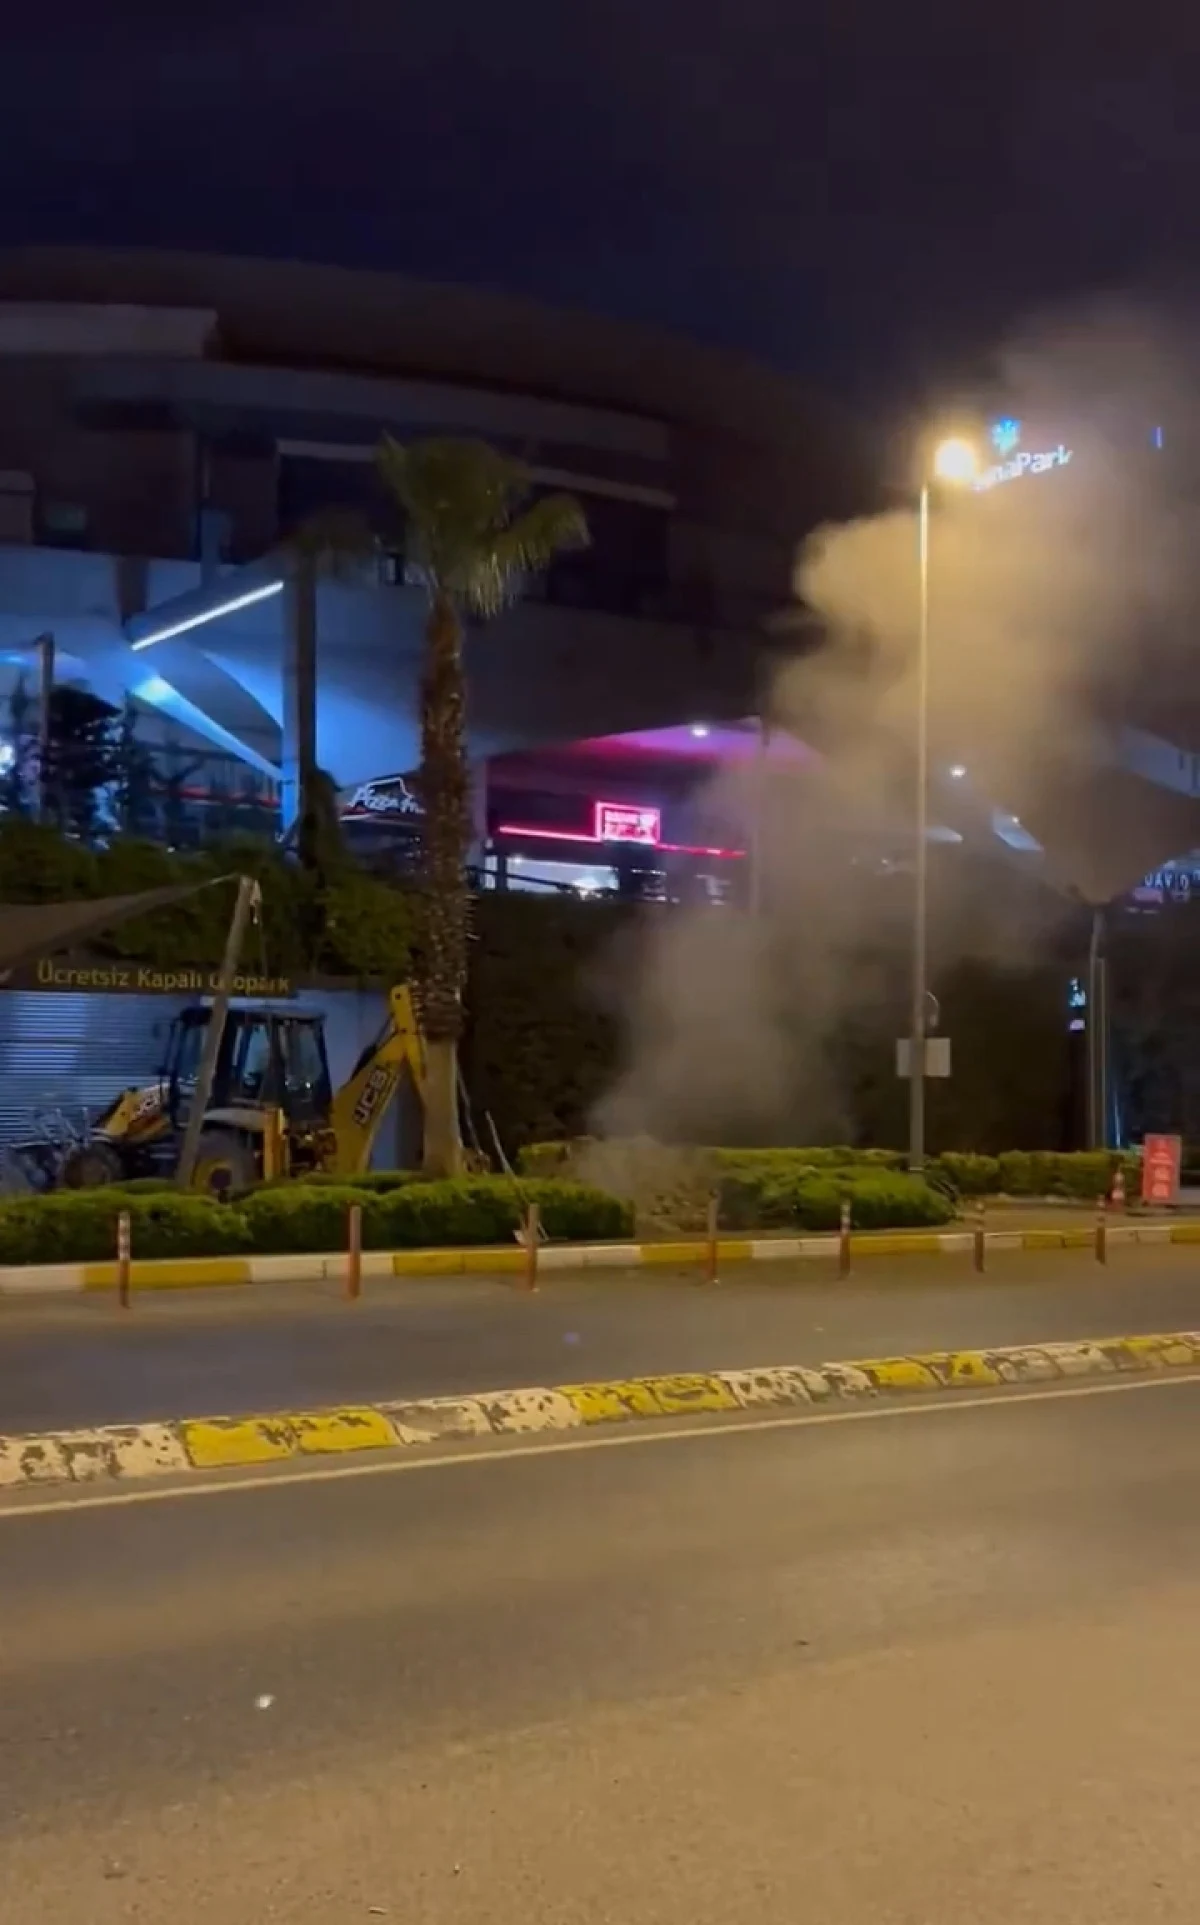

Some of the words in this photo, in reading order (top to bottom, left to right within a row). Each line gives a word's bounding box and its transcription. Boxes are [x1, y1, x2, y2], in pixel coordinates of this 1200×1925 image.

[37, 957, 130, 987] Ücretsiz
[137, 966, 203, 991] Kapalı
[208, 970, 290, 996] Oopark
[353, 1068, 388, 1125] JCB
